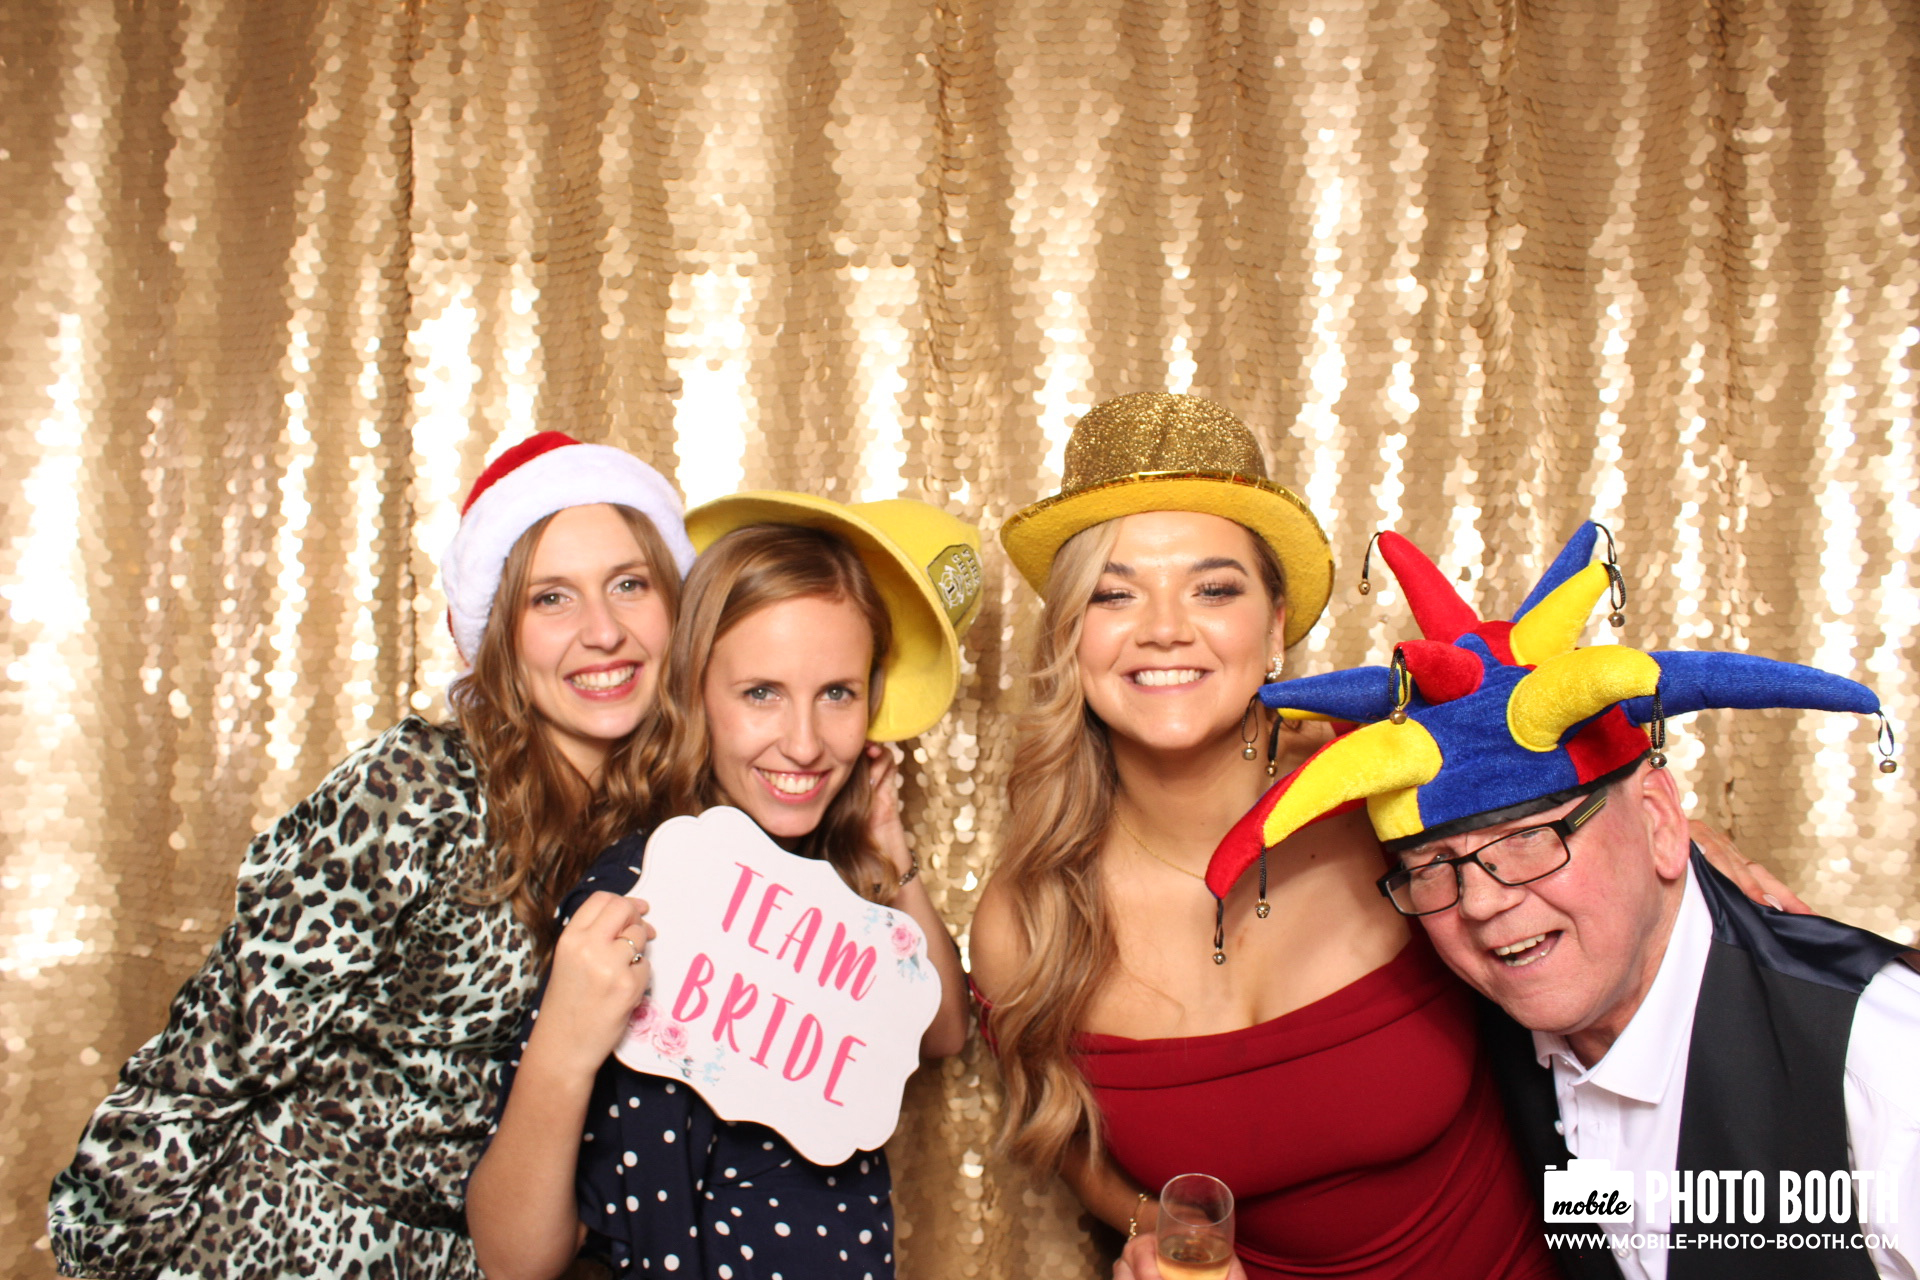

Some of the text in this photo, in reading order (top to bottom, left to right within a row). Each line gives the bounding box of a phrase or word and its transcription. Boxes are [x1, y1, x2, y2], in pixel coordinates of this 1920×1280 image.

[951, 553, 973, 596] CHIEF
[961, 549, 980, 587] FIRE
[721, 861, 877, 1001] TEAM
[671, 953, 867, 1106] BRIDE
